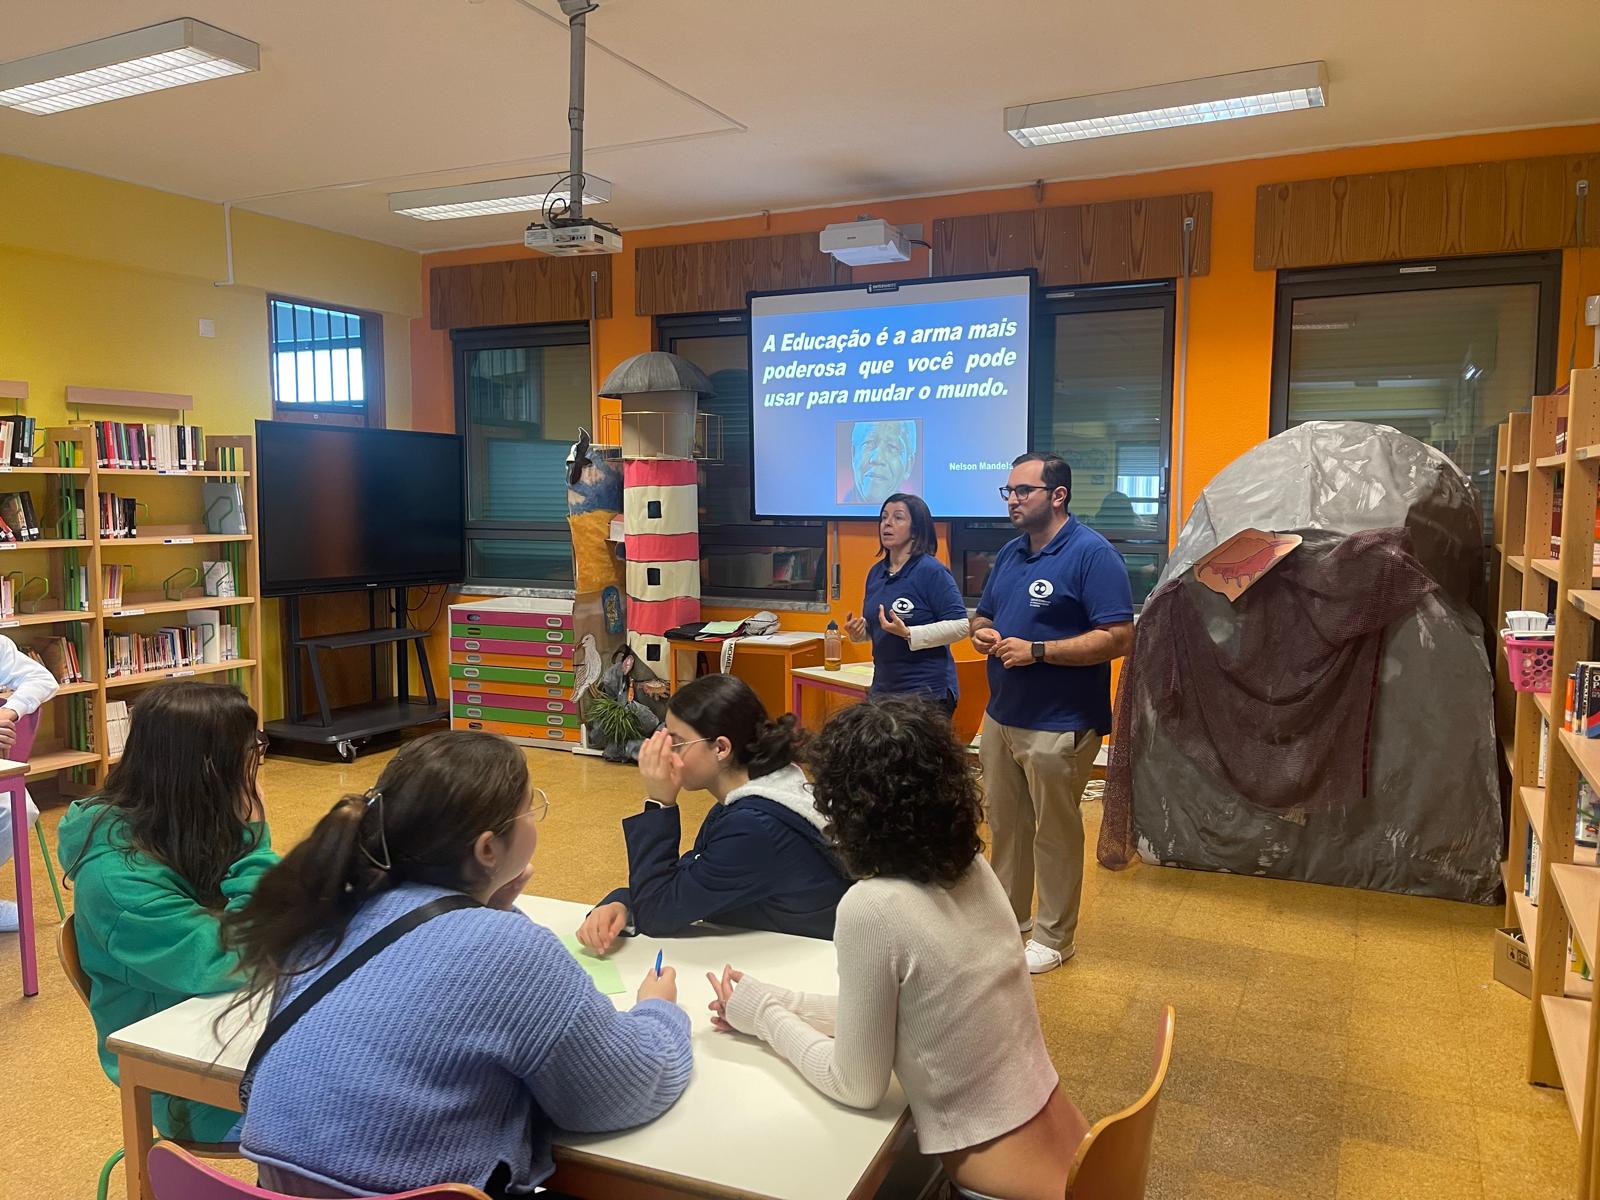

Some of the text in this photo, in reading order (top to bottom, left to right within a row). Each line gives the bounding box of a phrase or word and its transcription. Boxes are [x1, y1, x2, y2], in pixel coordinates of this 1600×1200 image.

[763, 318, 1018, 353] A Educação é a arma mais
[763, 347, 1017, 384] poderosa que você pode
[763, 378, 1008, 409] usar para mudar o mundo.
[949, 462, 977, 471] Nelson
